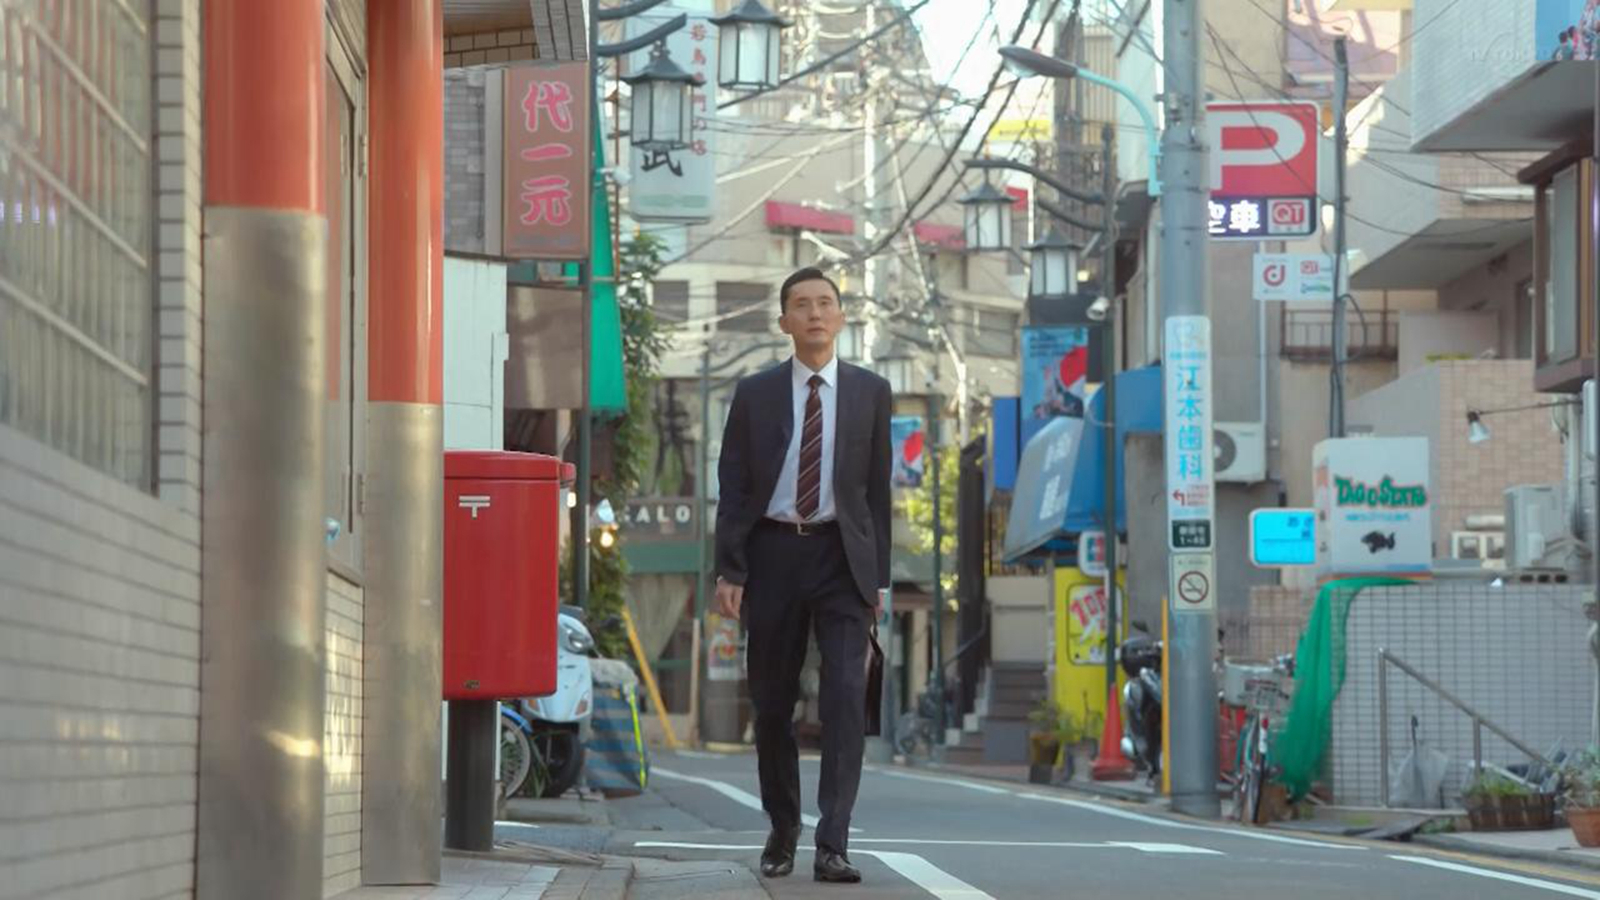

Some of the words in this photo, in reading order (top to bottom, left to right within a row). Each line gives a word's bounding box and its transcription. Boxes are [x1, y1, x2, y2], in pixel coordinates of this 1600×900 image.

[520, 80, 574, 226] 代一元
[1206, 111, 1305, 190] P
[1176, 365, 1203, 480] 江本歯科
